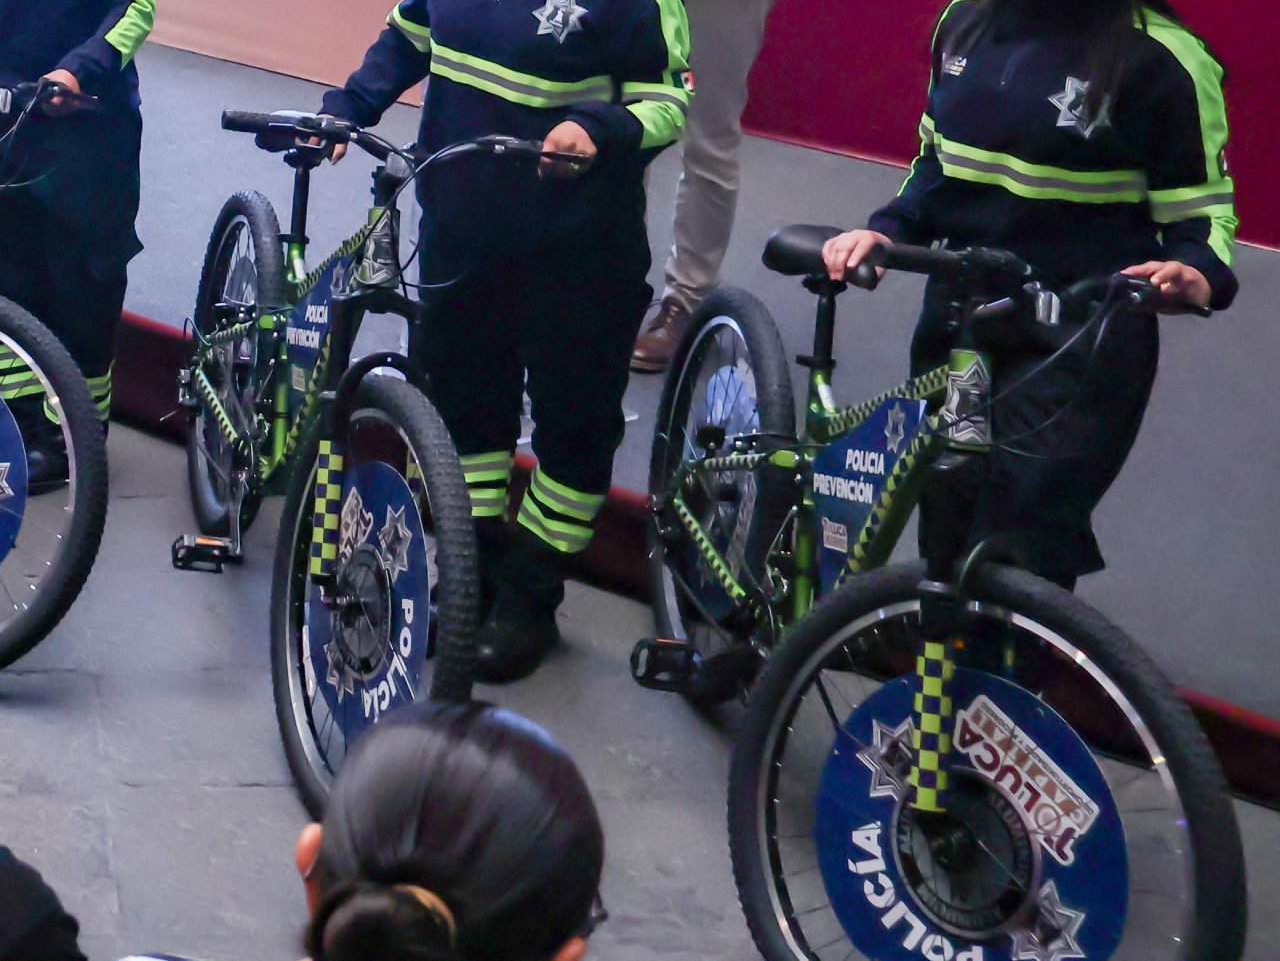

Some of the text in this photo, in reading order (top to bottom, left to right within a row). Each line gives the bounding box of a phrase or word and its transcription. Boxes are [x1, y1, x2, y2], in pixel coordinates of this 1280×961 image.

[813, 472, 873, 504] PREVENCIÓN
[958, 718, 1077, 862] TOLUCA
[975, 710, 1086, 823] CAPITAL
